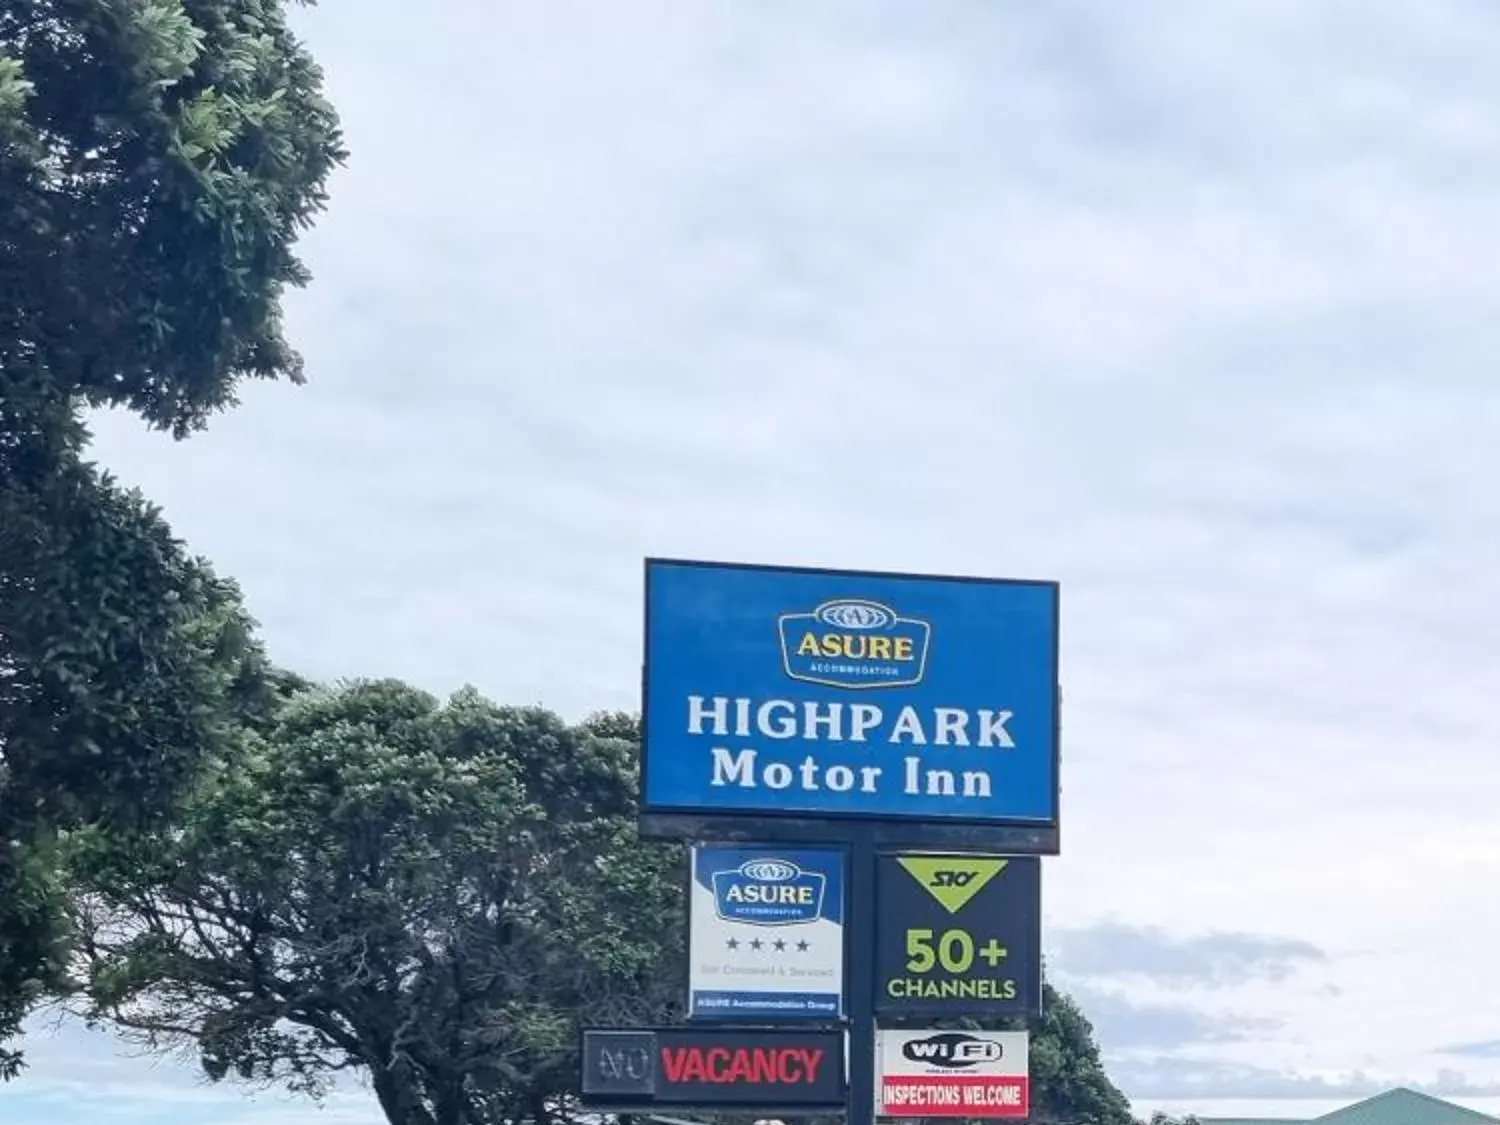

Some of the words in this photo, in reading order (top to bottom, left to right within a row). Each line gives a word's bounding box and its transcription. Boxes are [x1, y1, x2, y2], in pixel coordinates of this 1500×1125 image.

[797, 631, 915, 661] ASURE
[687, 696, 1016, 749] HIGHPARK
[710, 748, 883, 794] Motor
[903, 756, 993, 798] Inn
[726, 883, 814, 905] ASURE
[930, 871, 981, 887] SKY
[905, 928, 1008, 974] 50+
[887, 978, 1016, 999] CHANNELS
[661, 1047, 824, 1083] VACANCY
[883, 1085, 961, 1106] INSPECTIONS
[962, 1085, 1022, 1106] WELCOME
